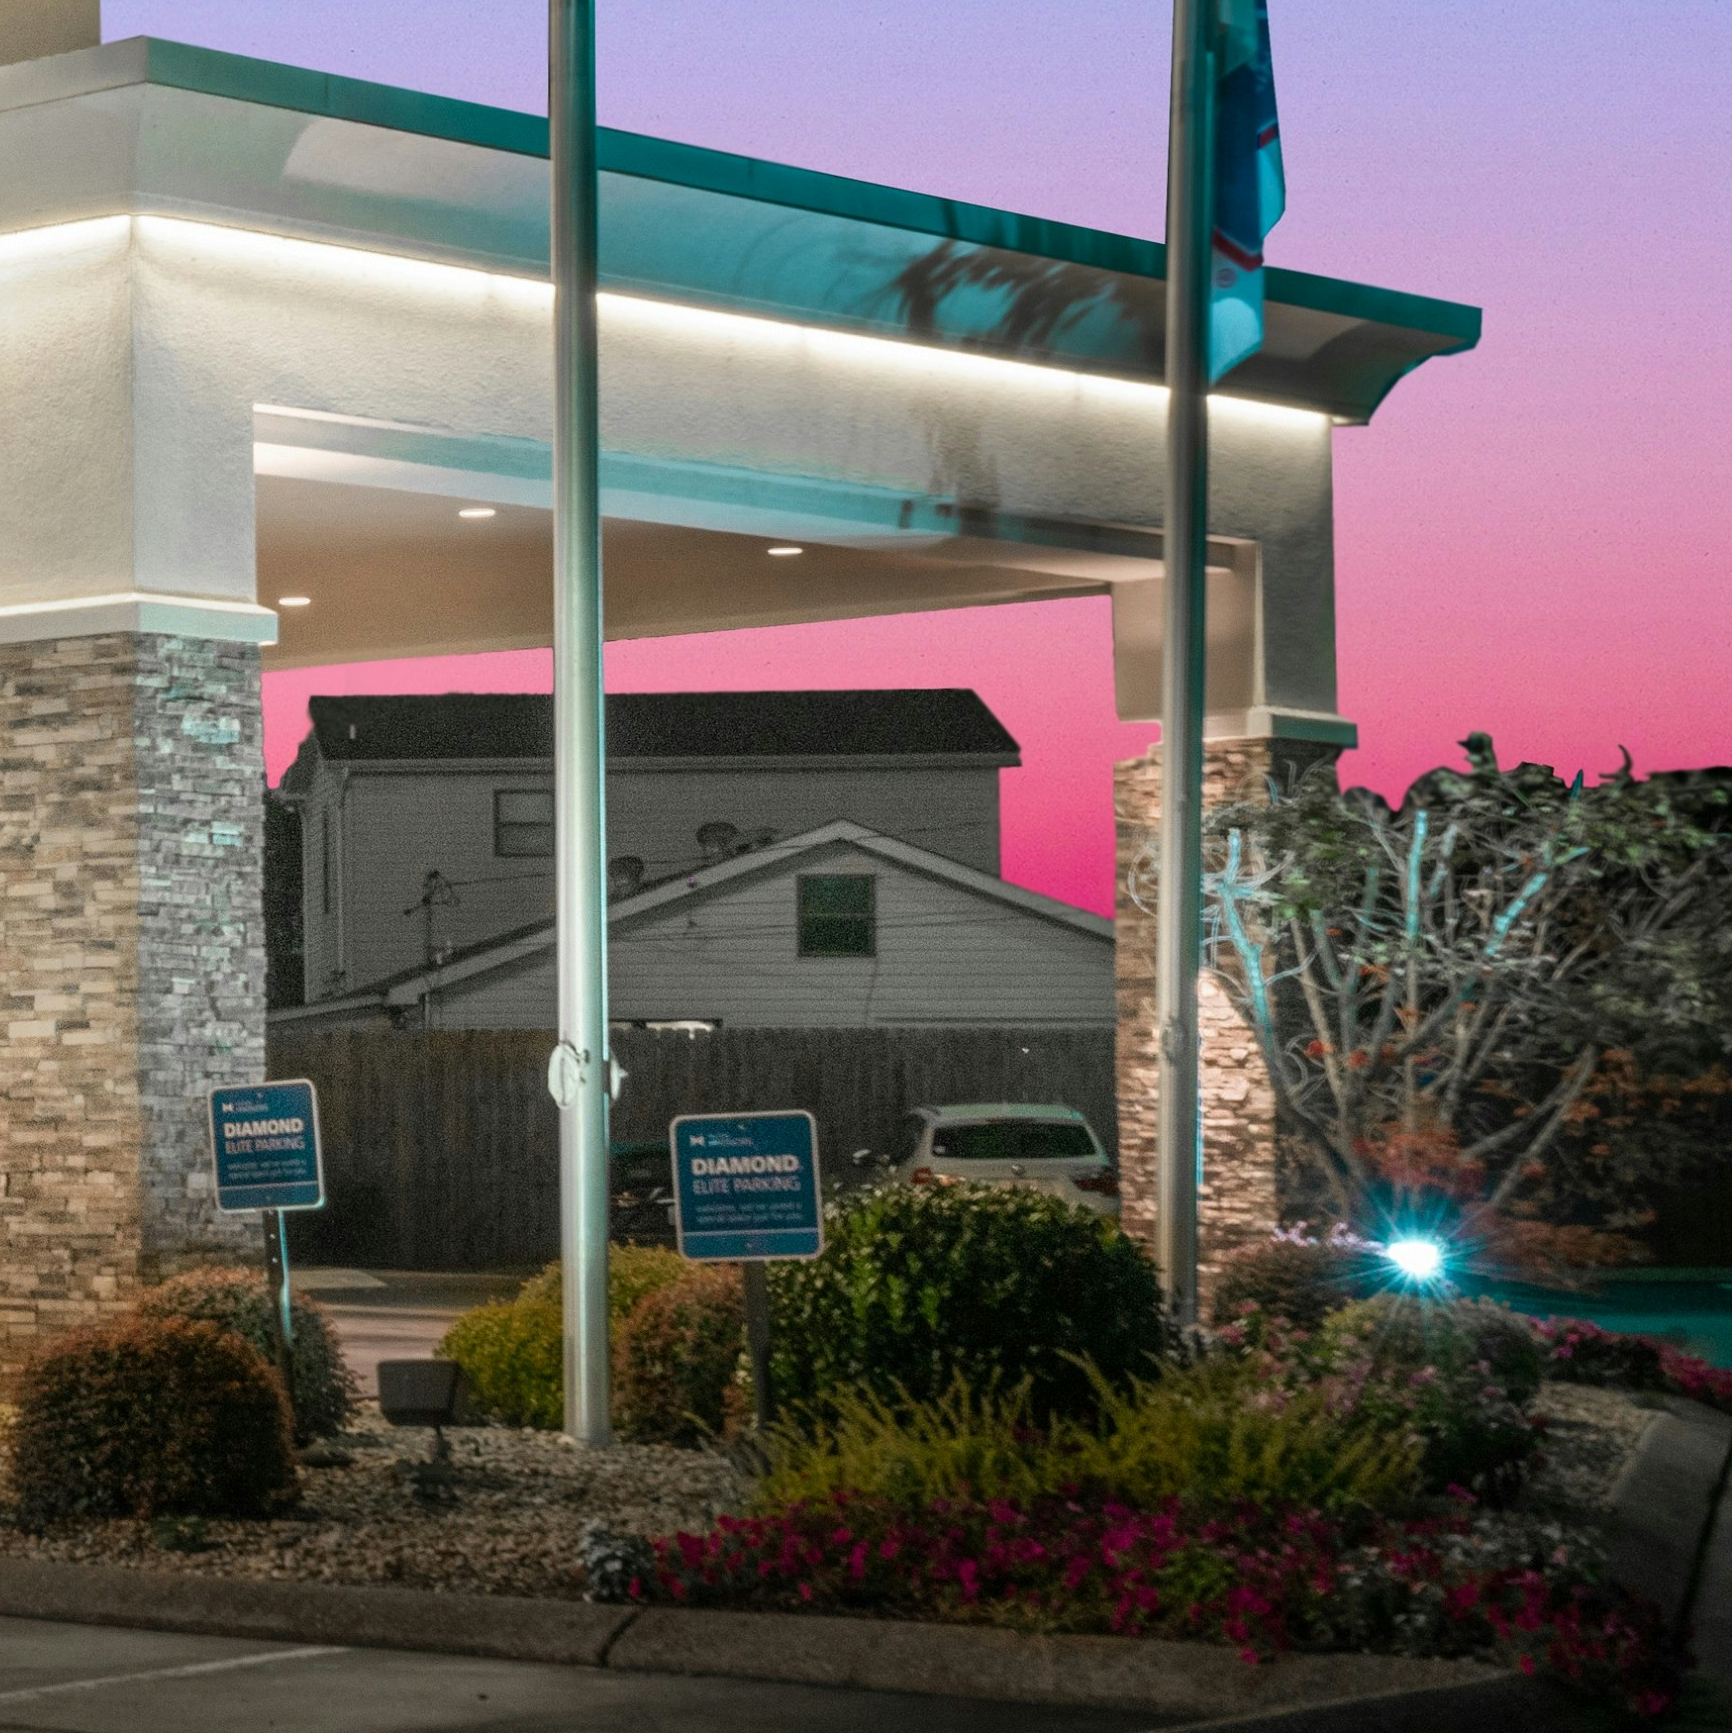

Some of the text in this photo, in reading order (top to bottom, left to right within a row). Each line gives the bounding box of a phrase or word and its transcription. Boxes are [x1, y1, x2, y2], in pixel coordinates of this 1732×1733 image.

[224, 1118, 304, 1138] DIAMOND
[225, 1135, 305, 1154] ELITE PARKING
[691, 1155, 799, 1176] DIAMOND
[693, 1176, 801, 1194] ELITE PARKING
